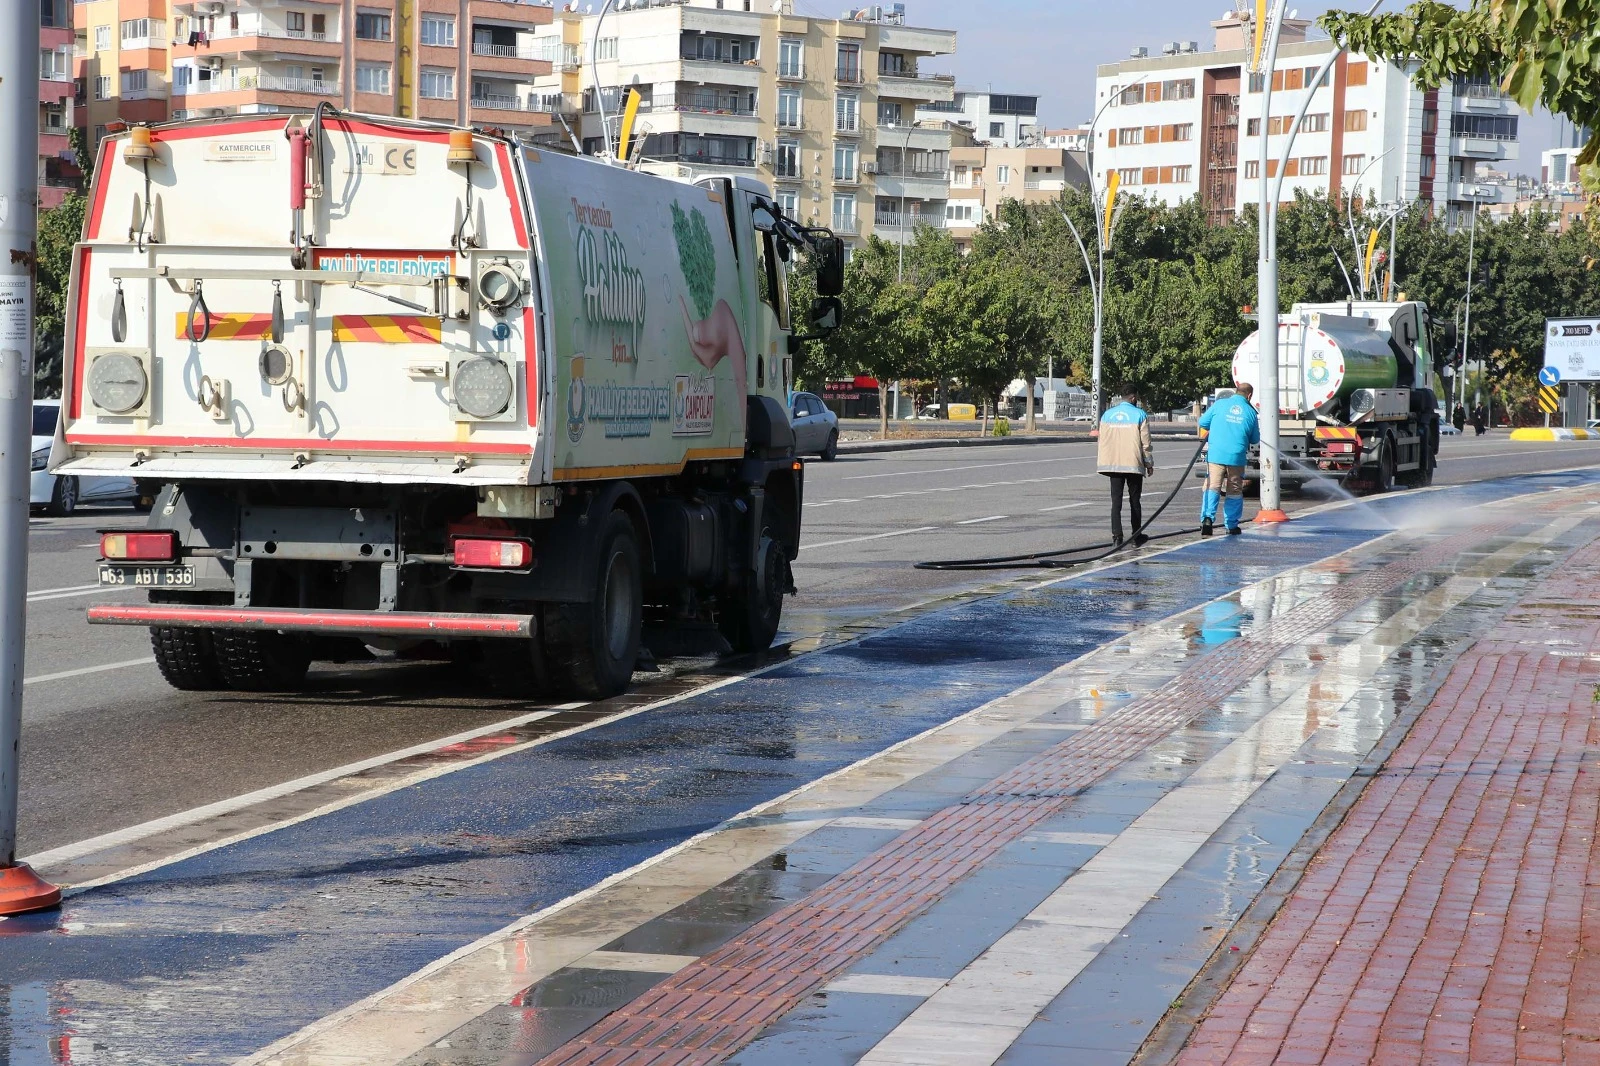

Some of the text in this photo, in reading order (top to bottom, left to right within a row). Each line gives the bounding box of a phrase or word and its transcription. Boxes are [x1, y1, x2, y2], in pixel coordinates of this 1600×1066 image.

[385, 148, 415, 169] CE
[571, 197, 613, 229] Tertemiz
[108, 568, 192, 584] 63 ABY 536
